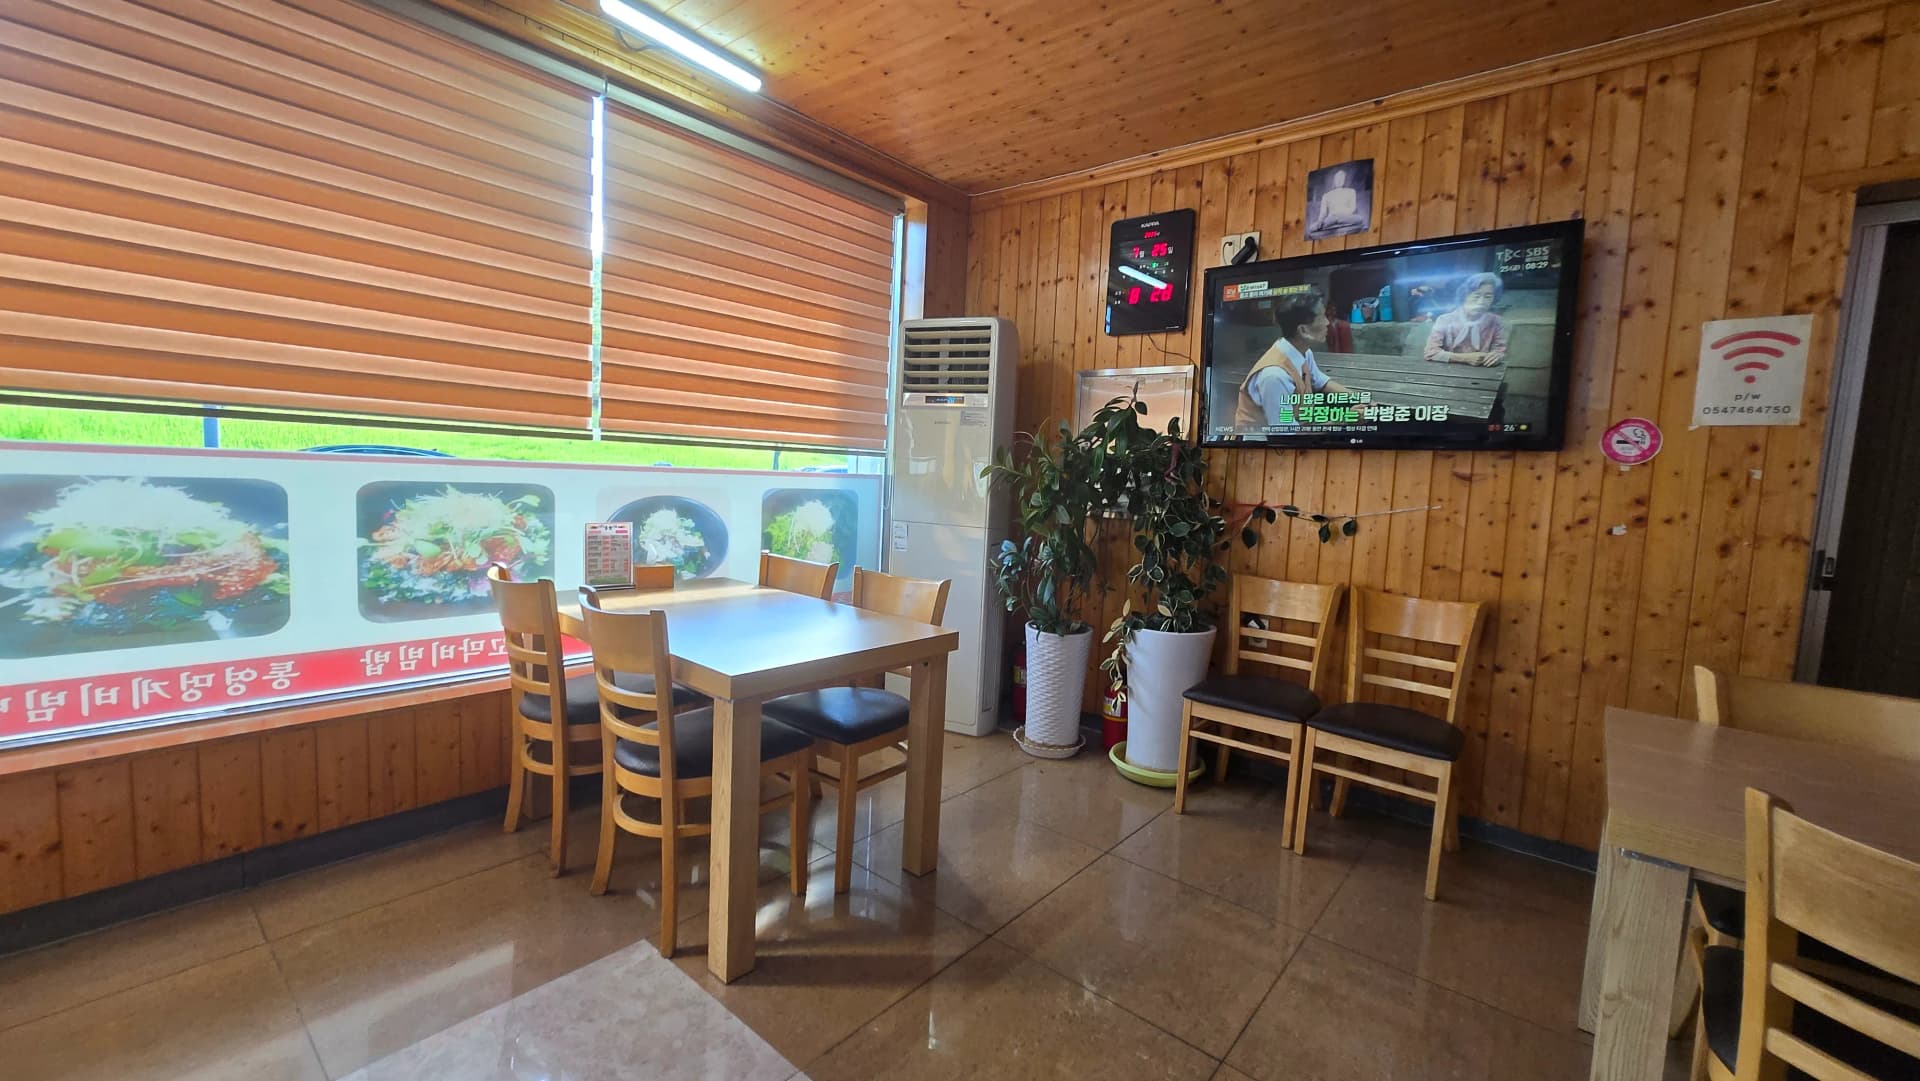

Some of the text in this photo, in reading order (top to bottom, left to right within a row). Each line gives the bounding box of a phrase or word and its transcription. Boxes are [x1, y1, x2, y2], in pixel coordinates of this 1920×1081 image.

[1495, 248, 1521, 263] TBC
[1526, 246, 1551, 257] SBS
[1525, 261, 1549, 271] 08:29
[1280, 391, 1372, 405] 나이 많은 어르신을
[1734, 392, 1761, 402] p/w
[1298, 406, 1360, 423] 걱정하는
[1363, 405, 1411, 422] 박병준
[1414, 404, 1450, 422] 이장
[1702, 405, 1792, 415] 0547464750
